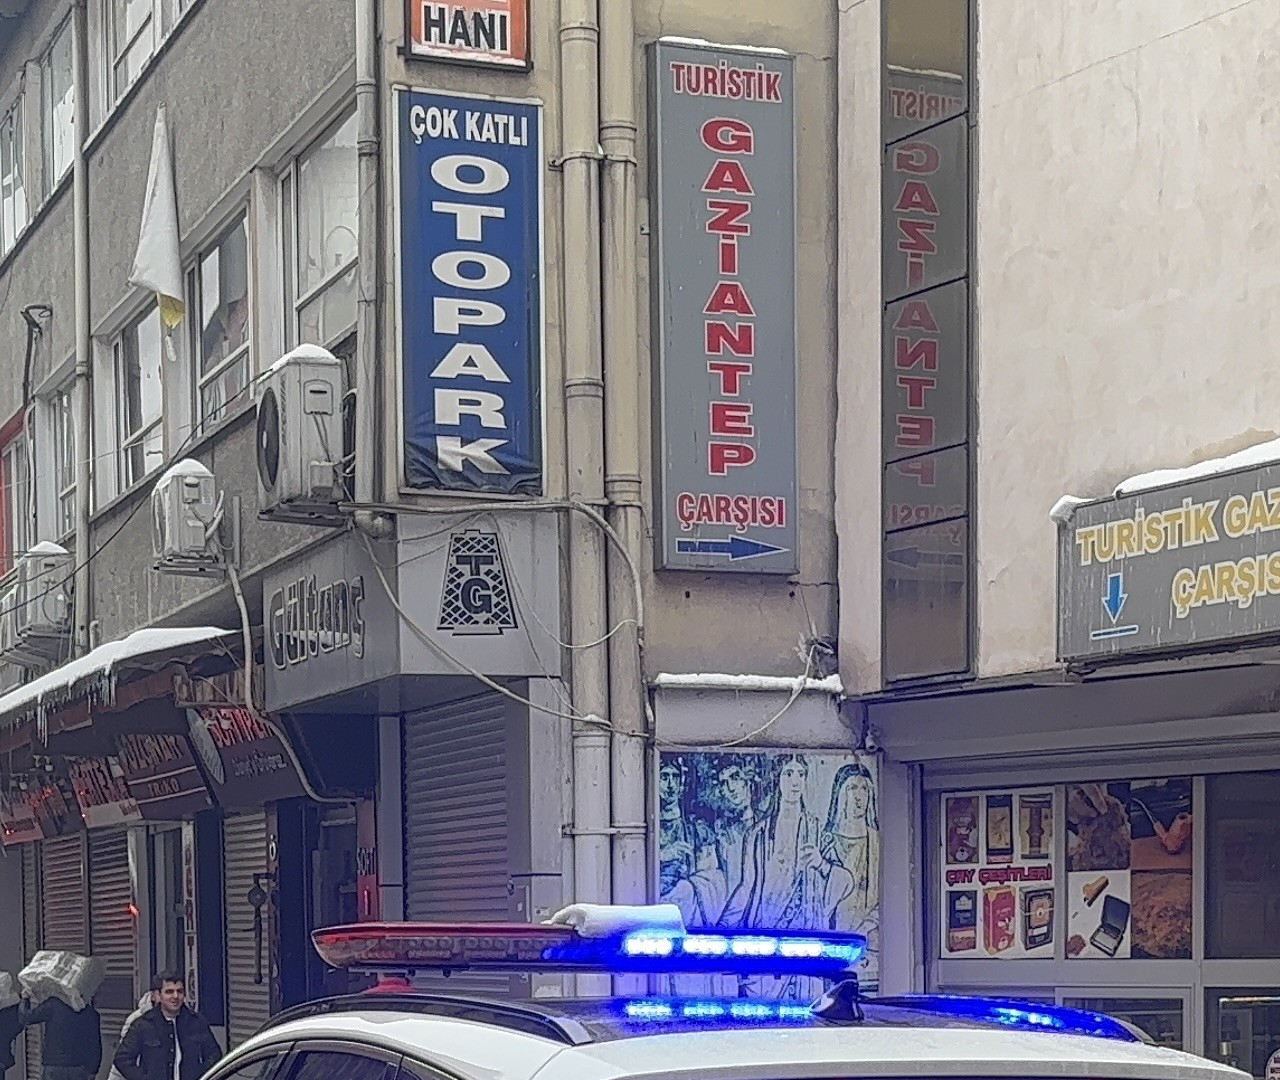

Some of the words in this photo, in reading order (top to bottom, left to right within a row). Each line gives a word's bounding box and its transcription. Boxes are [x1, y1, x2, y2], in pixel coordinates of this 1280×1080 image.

[423, 5, 508, 51] HANI
[671, 59, 782, 102] TURİSTİK
[410, 105, 459, 144] ÇOK
[465, 111, 528, 146] KATLI
[429, 155, 511, 475] OTOPARK
[700, 117, 755, 476] GAZİANTEP
[676, 493, 786, 532] ÇARŞISI
[1076, 496, 1220, 566] TURİSTİK
[455, 555, 494, 614] TG
